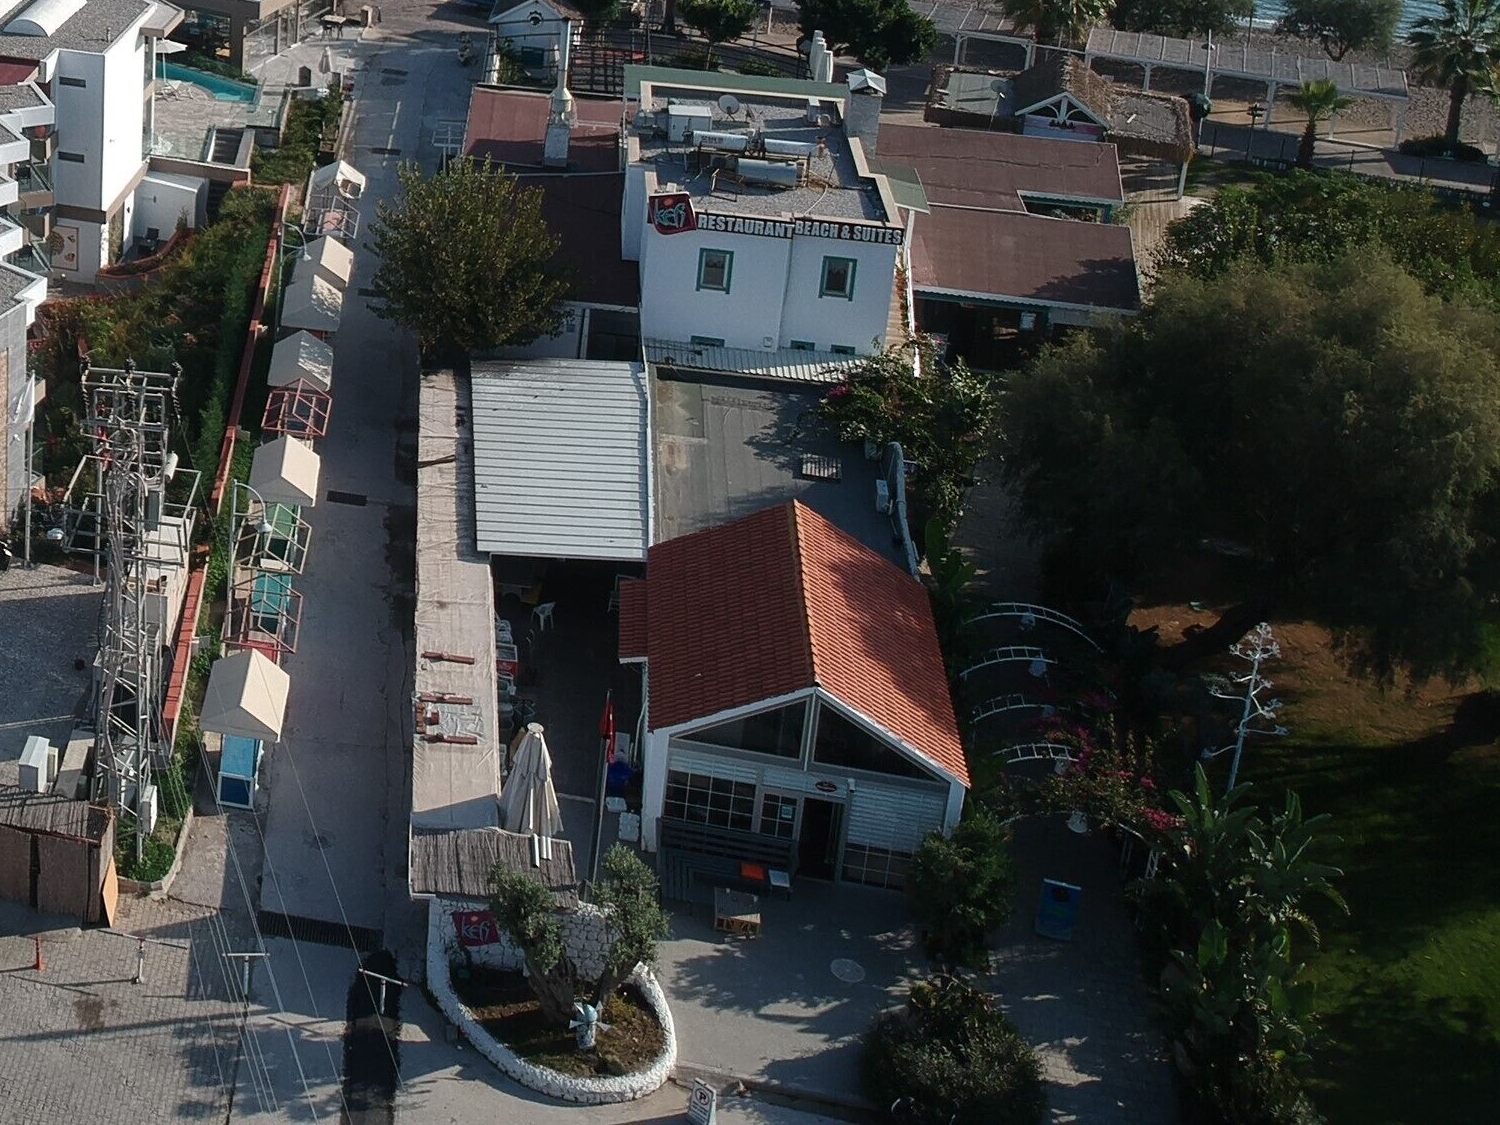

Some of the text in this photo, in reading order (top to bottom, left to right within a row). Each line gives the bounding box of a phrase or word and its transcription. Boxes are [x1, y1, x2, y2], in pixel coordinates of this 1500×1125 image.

[698, 214, 795, 238] RESTAURANT
[795, 220, 902, 245] BEACH & SUITES
